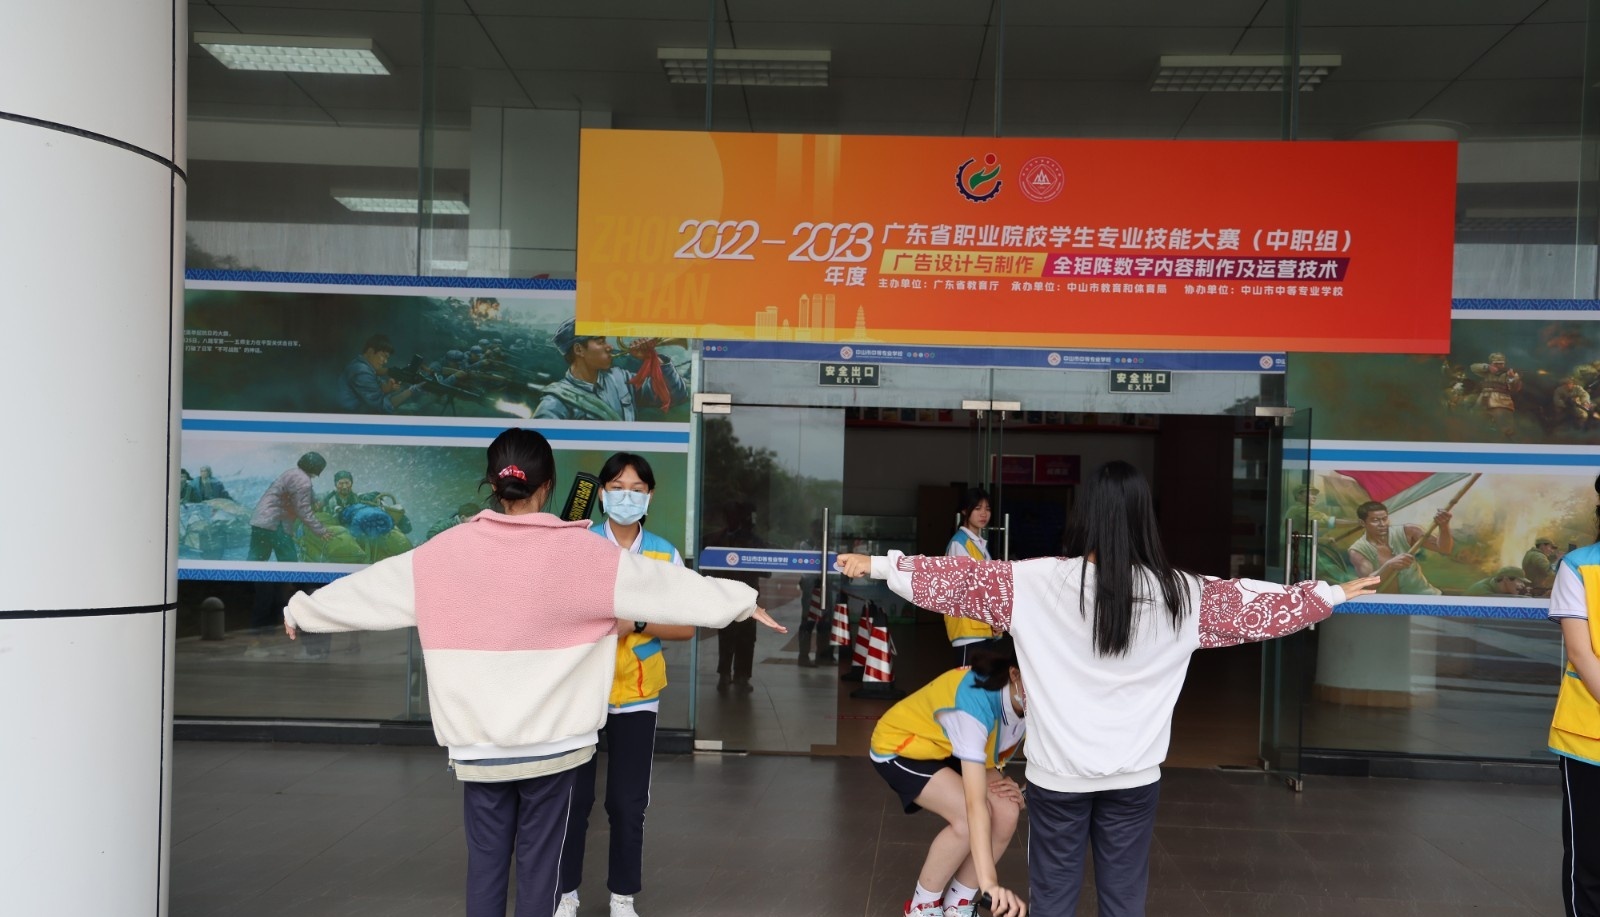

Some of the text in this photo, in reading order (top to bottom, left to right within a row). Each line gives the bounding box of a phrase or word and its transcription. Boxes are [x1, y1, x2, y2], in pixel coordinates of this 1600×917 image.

[892, 252, 1035, 275] 广告设计与制作
[1052, 255, 1339, 280] 全矩阵数字内容制作及运营技术
[824, 266, 868, 287] 年度
[825, 365, 874, 377] 安全出口
[1116, 372, 1166, 385] 安全出口
[1128, 383, 1154, 391] EXIT
